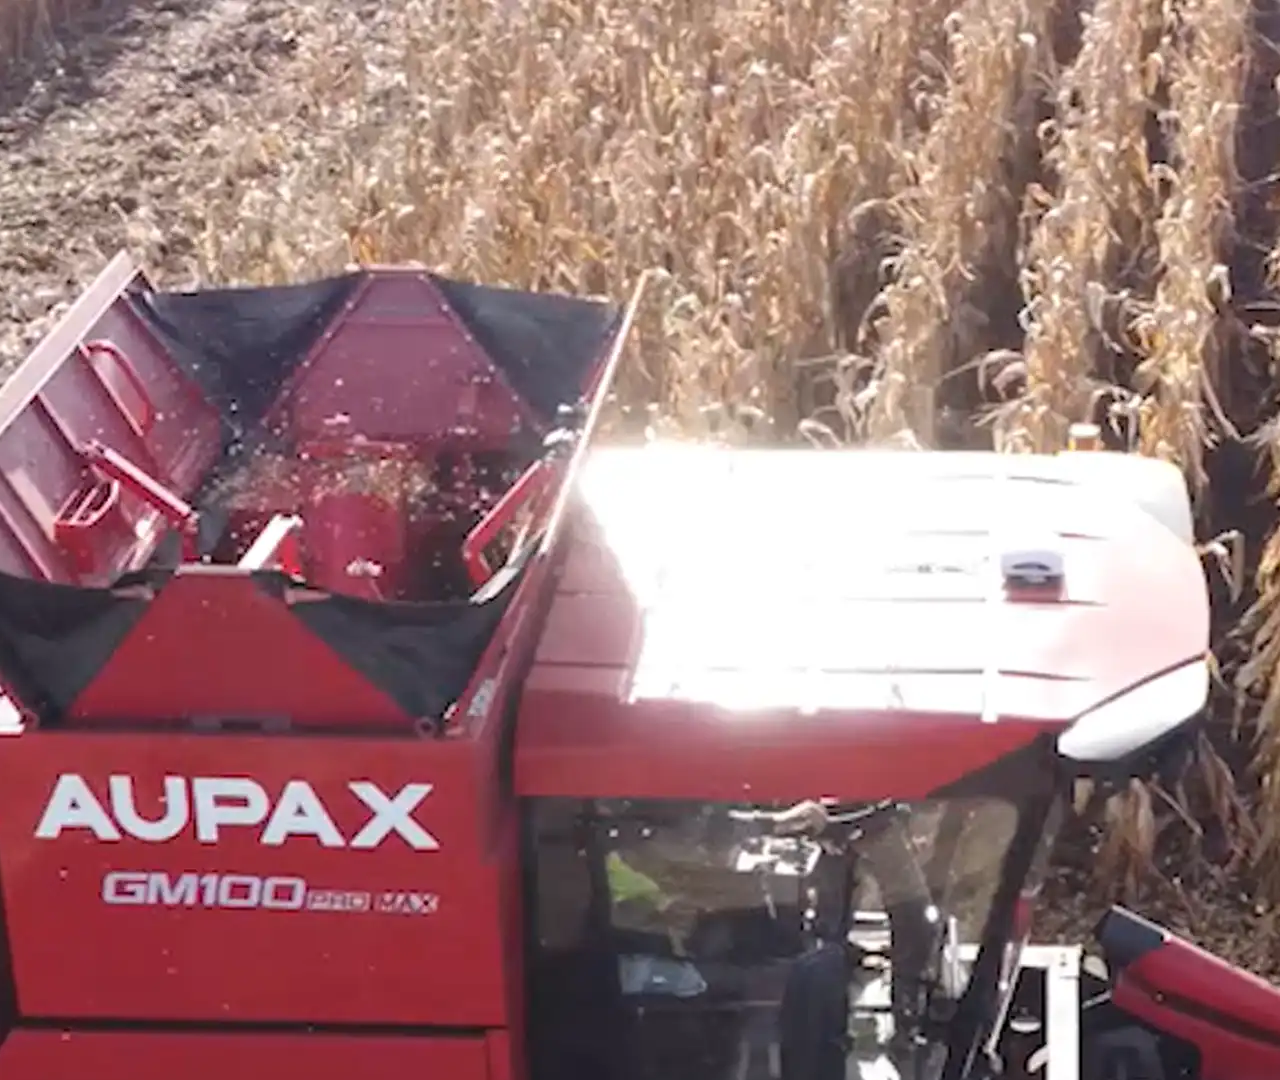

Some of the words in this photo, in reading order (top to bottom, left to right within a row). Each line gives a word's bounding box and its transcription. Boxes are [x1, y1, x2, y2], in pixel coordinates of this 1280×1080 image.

[34, 773, 440, 850] AUPAX
[102, 870, 306, 911] GM100
[307, 890, 371, 912] PRO
[374, 892, 440, 915] MAX
